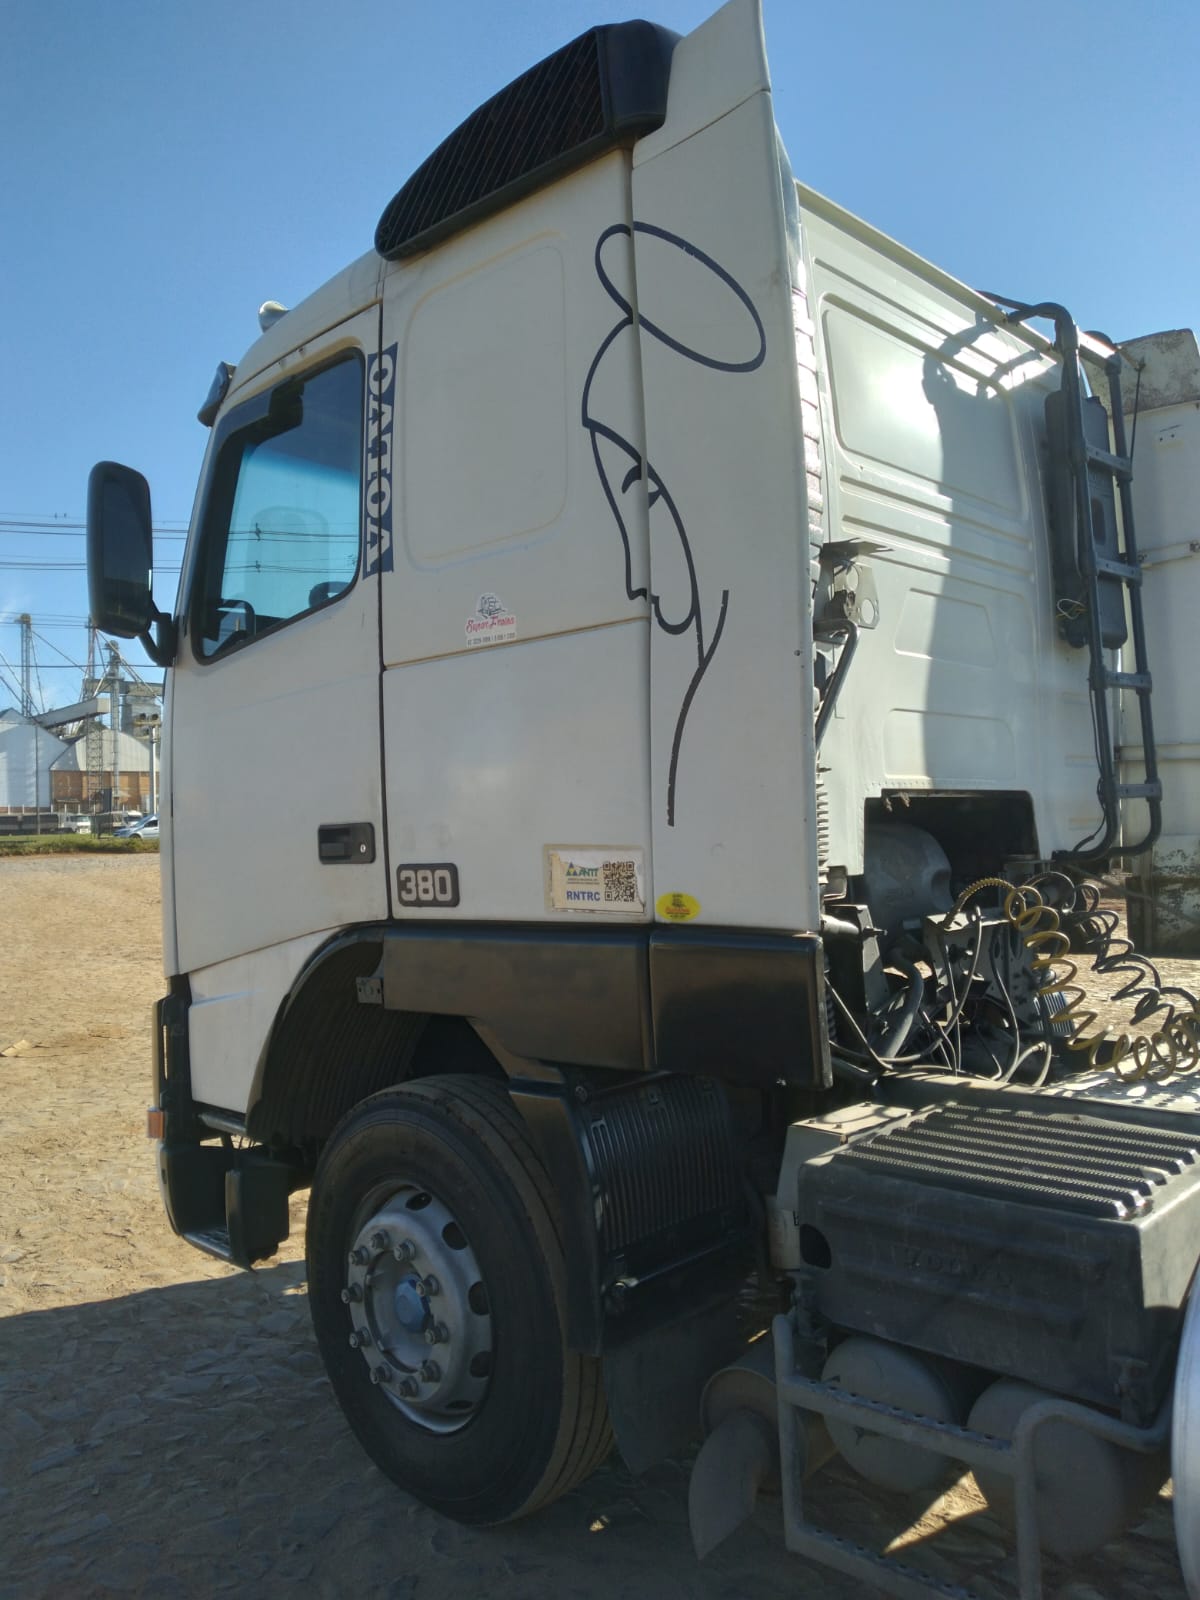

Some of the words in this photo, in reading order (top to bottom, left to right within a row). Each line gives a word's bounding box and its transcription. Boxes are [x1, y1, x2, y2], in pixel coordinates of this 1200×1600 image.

[366, 353, 394, 573] VOLVO
[400, 869, 452, 901] 380
[566, 890, 601, 901] RNTRC
